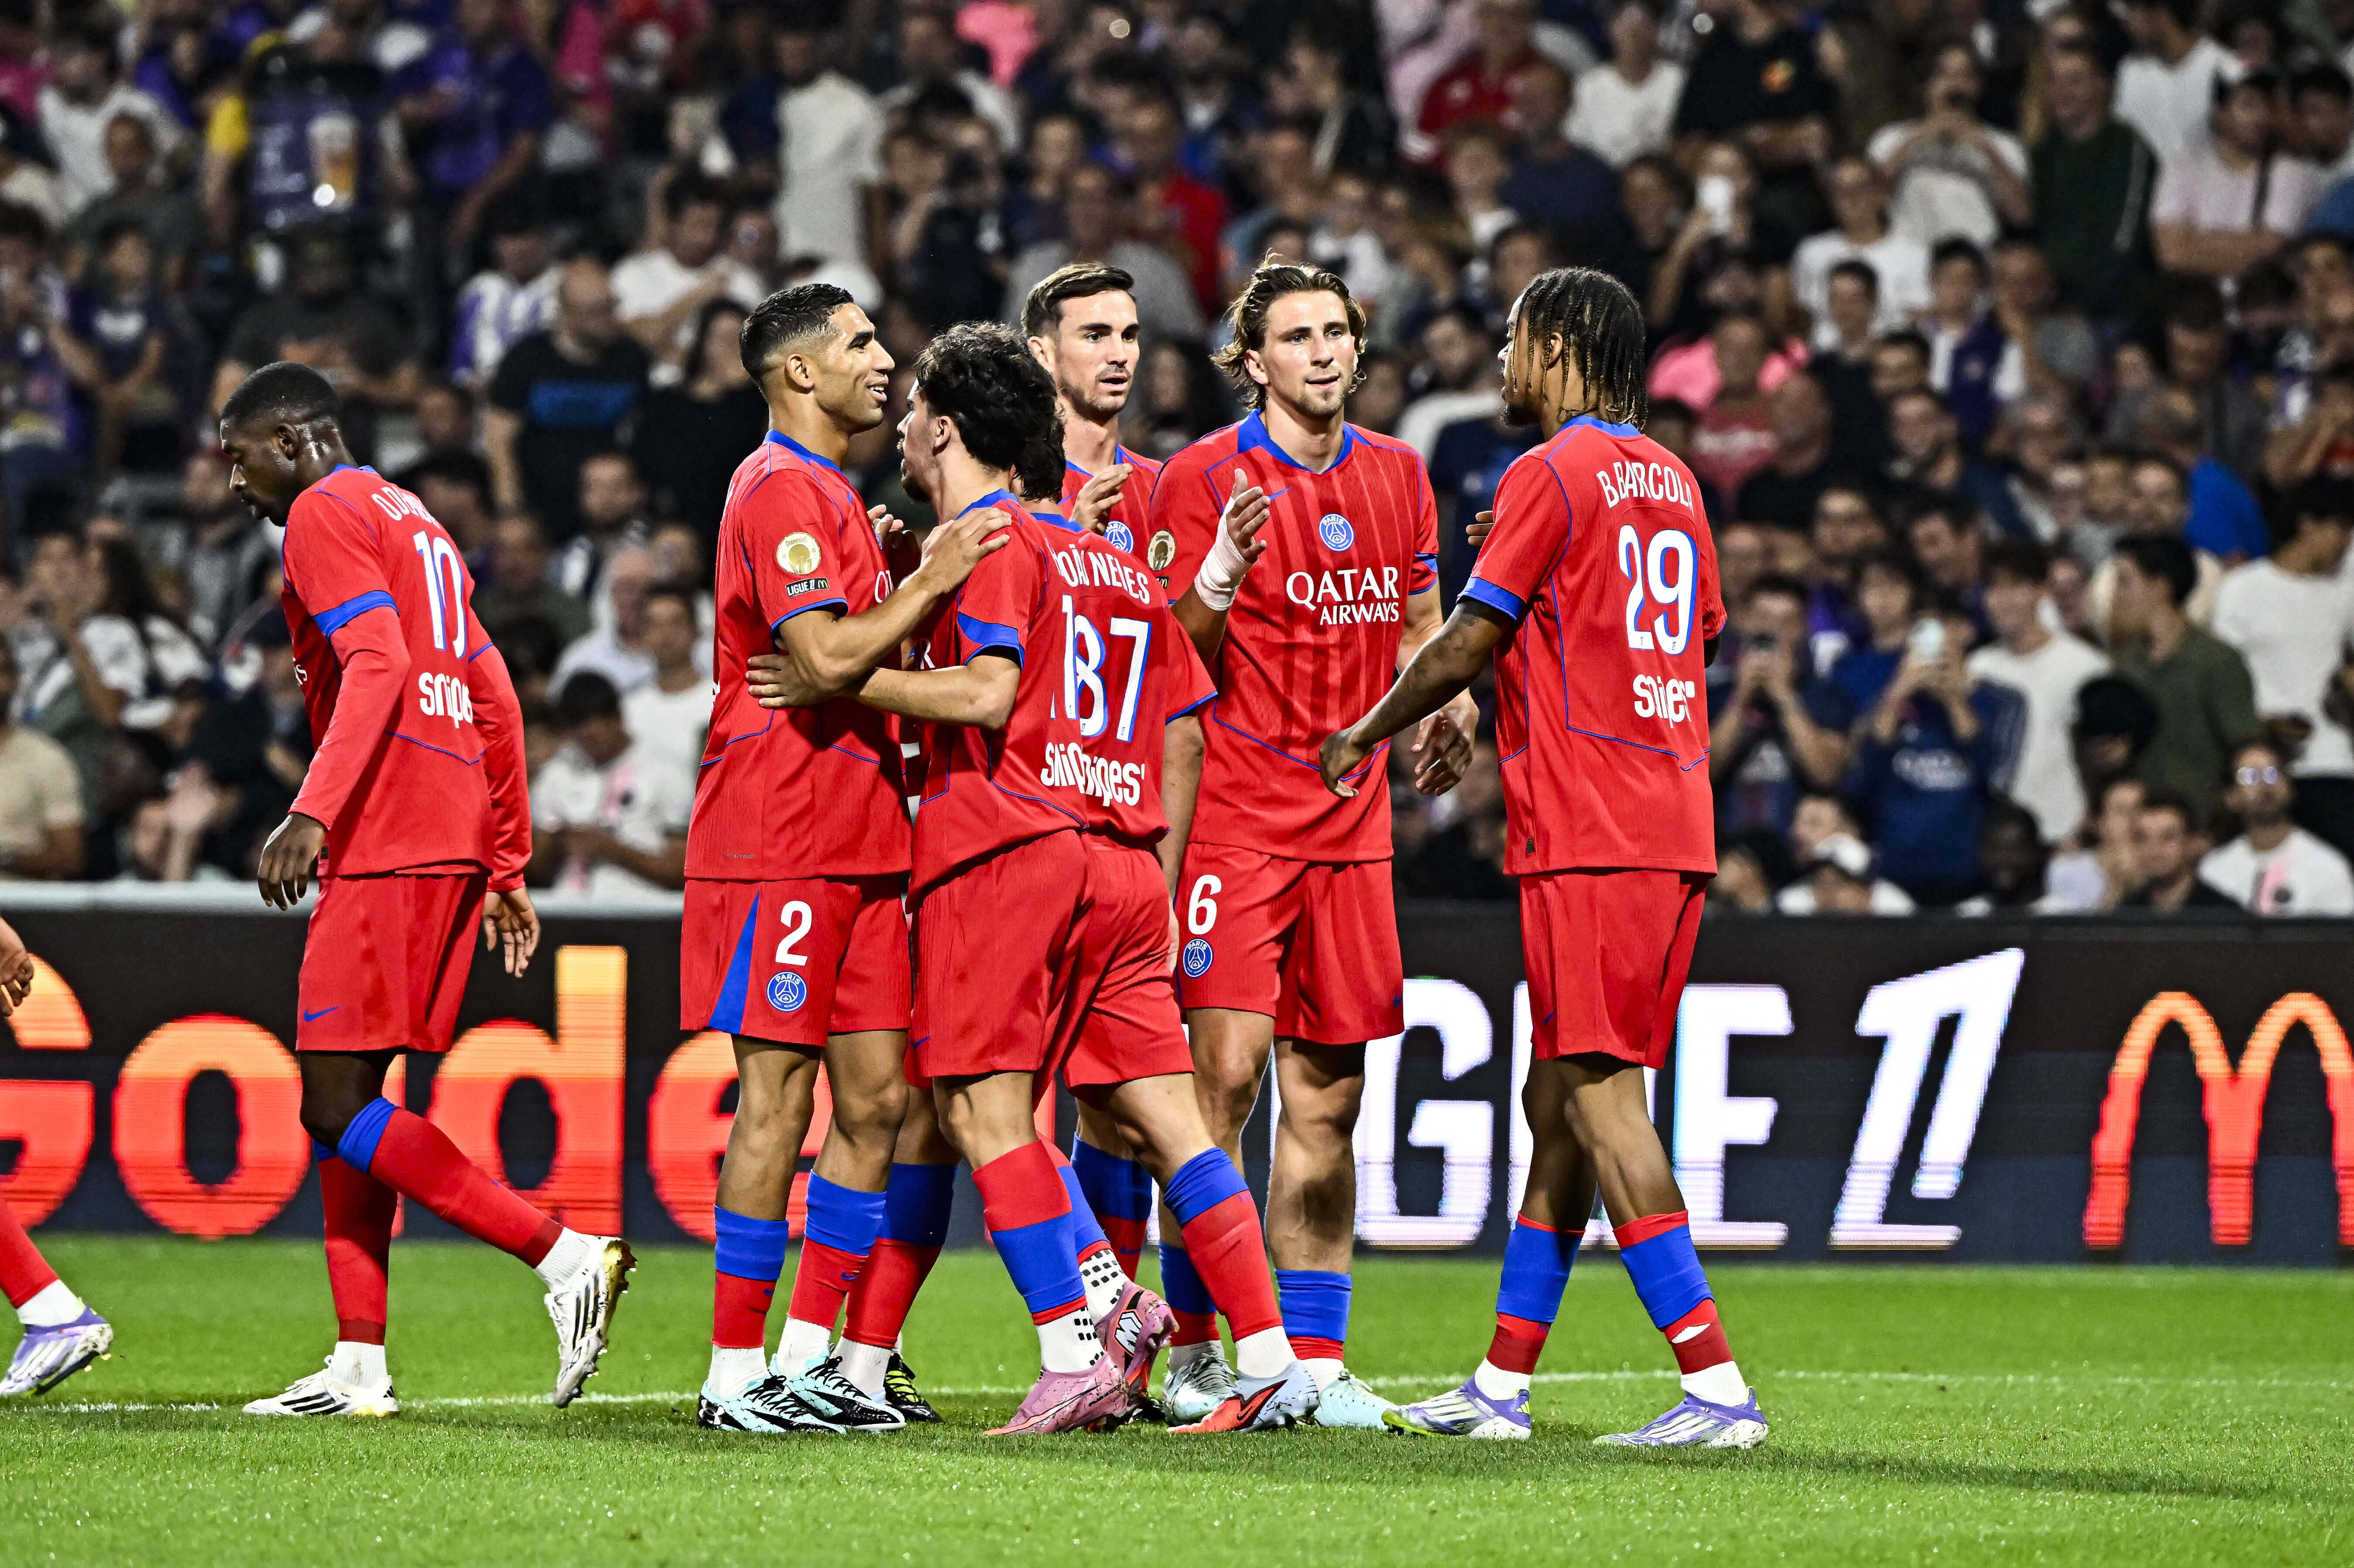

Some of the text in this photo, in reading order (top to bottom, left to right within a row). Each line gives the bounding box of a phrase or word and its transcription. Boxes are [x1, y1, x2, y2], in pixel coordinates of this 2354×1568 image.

[1322, 516, 1344, 526] PARIS
[413, 530, 467, 659] 10
[787, 581, 809, 596] LIGUE
[1286, 567, 1399, 611] QATAR
[1618, 524, 1699, 655] 29
[1319, 602, 1399, 626] AIRWAYS
[1633, 674, 1693, 729] snies
[1187, 874, 1222, 935] 6
[775, 900, 812, 966] 2
[1187, 941, 1208, 950] PARIS
[775, 973, 801, 985] PARIS
